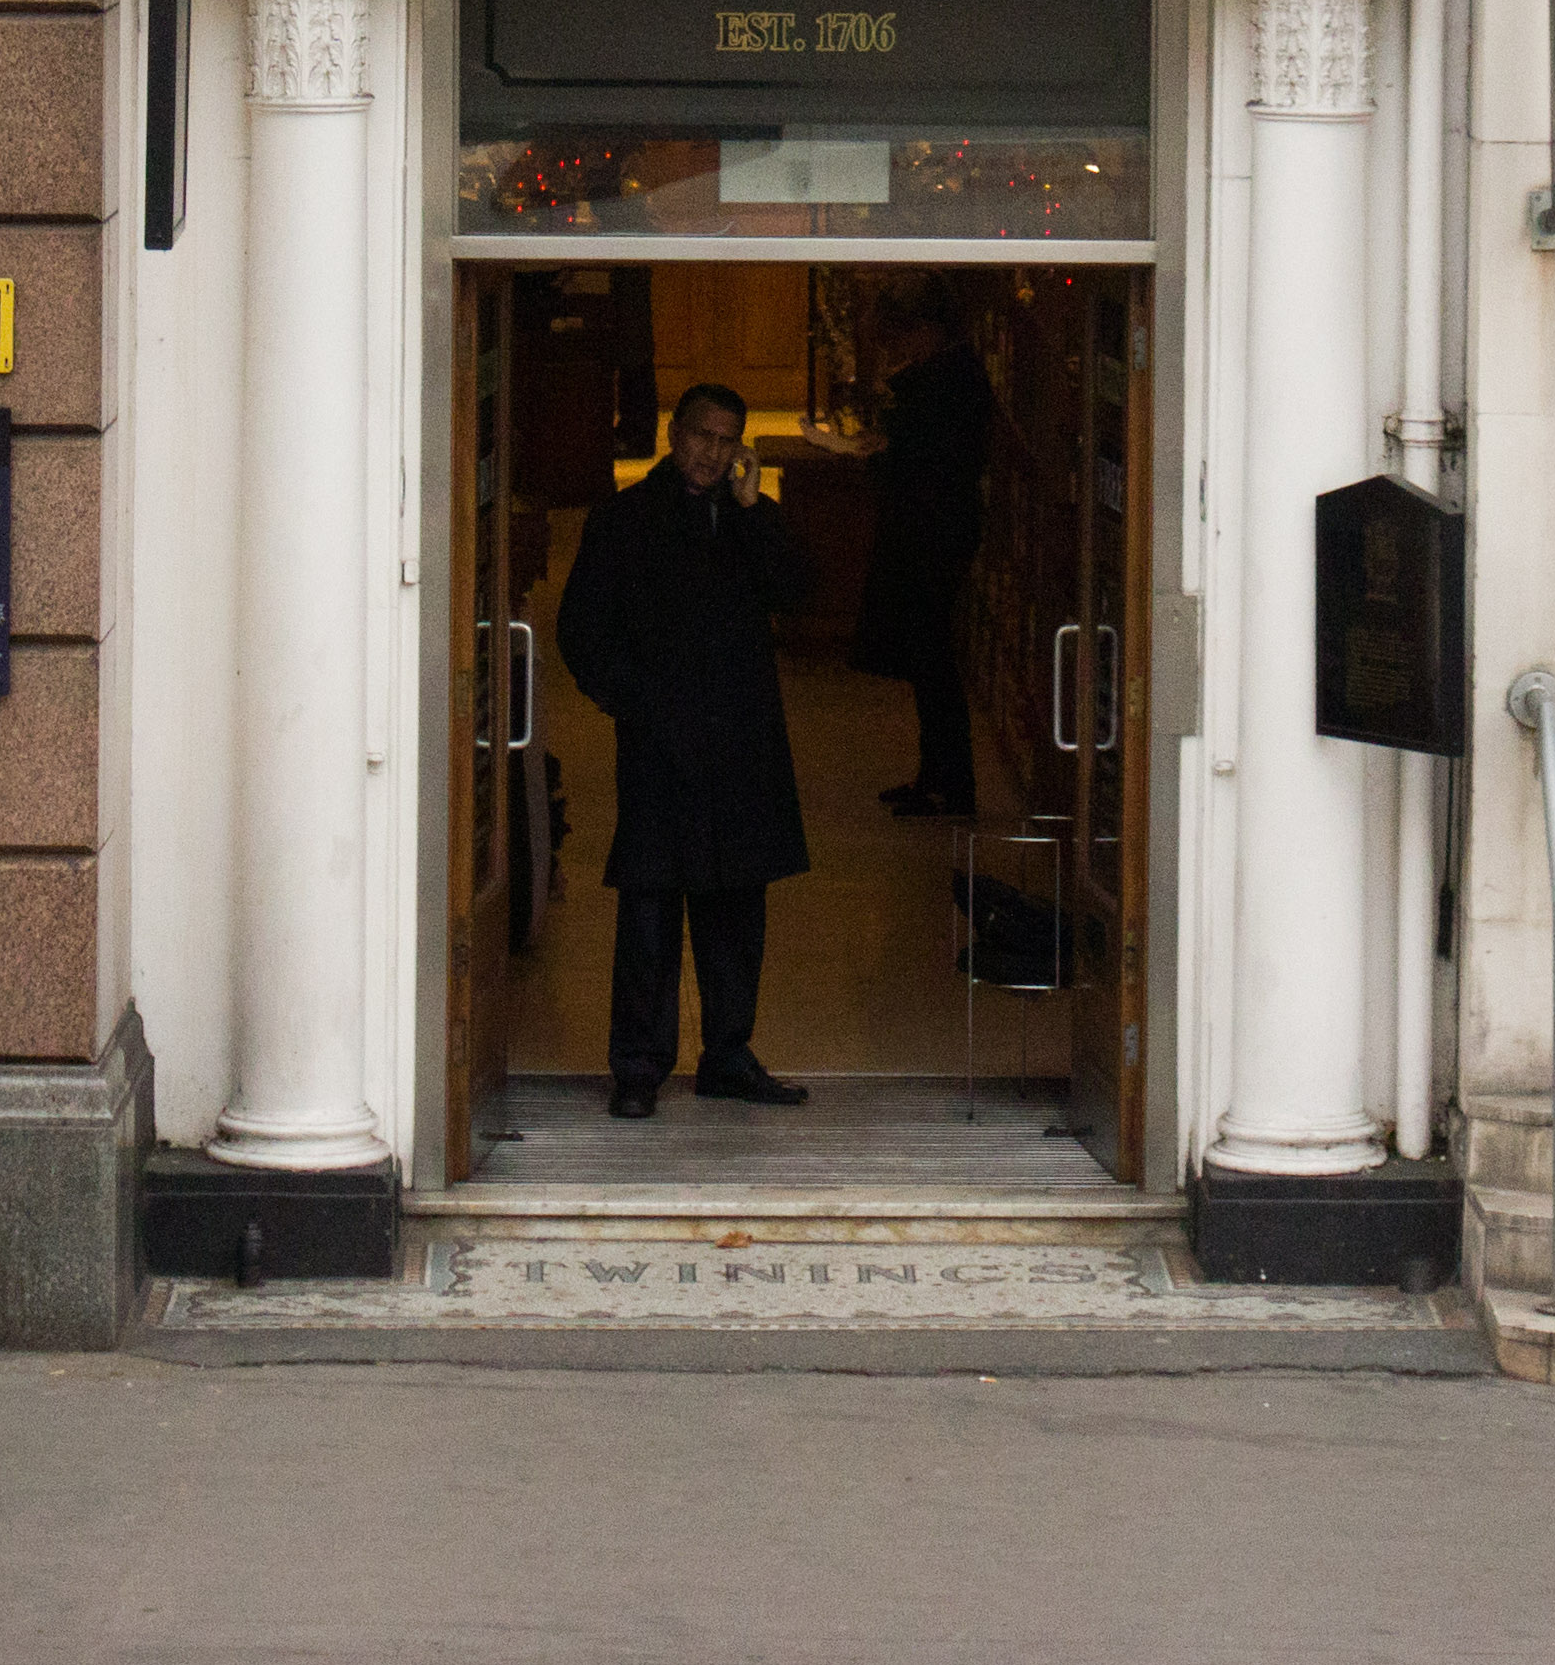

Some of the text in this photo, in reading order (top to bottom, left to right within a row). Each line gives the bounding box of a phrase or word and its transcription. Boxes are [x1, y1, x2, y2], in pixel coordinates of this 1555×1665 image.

[715, 12, 897, 53] EST. 1706
[509, 1258, 1100, 1287] TWININGS
